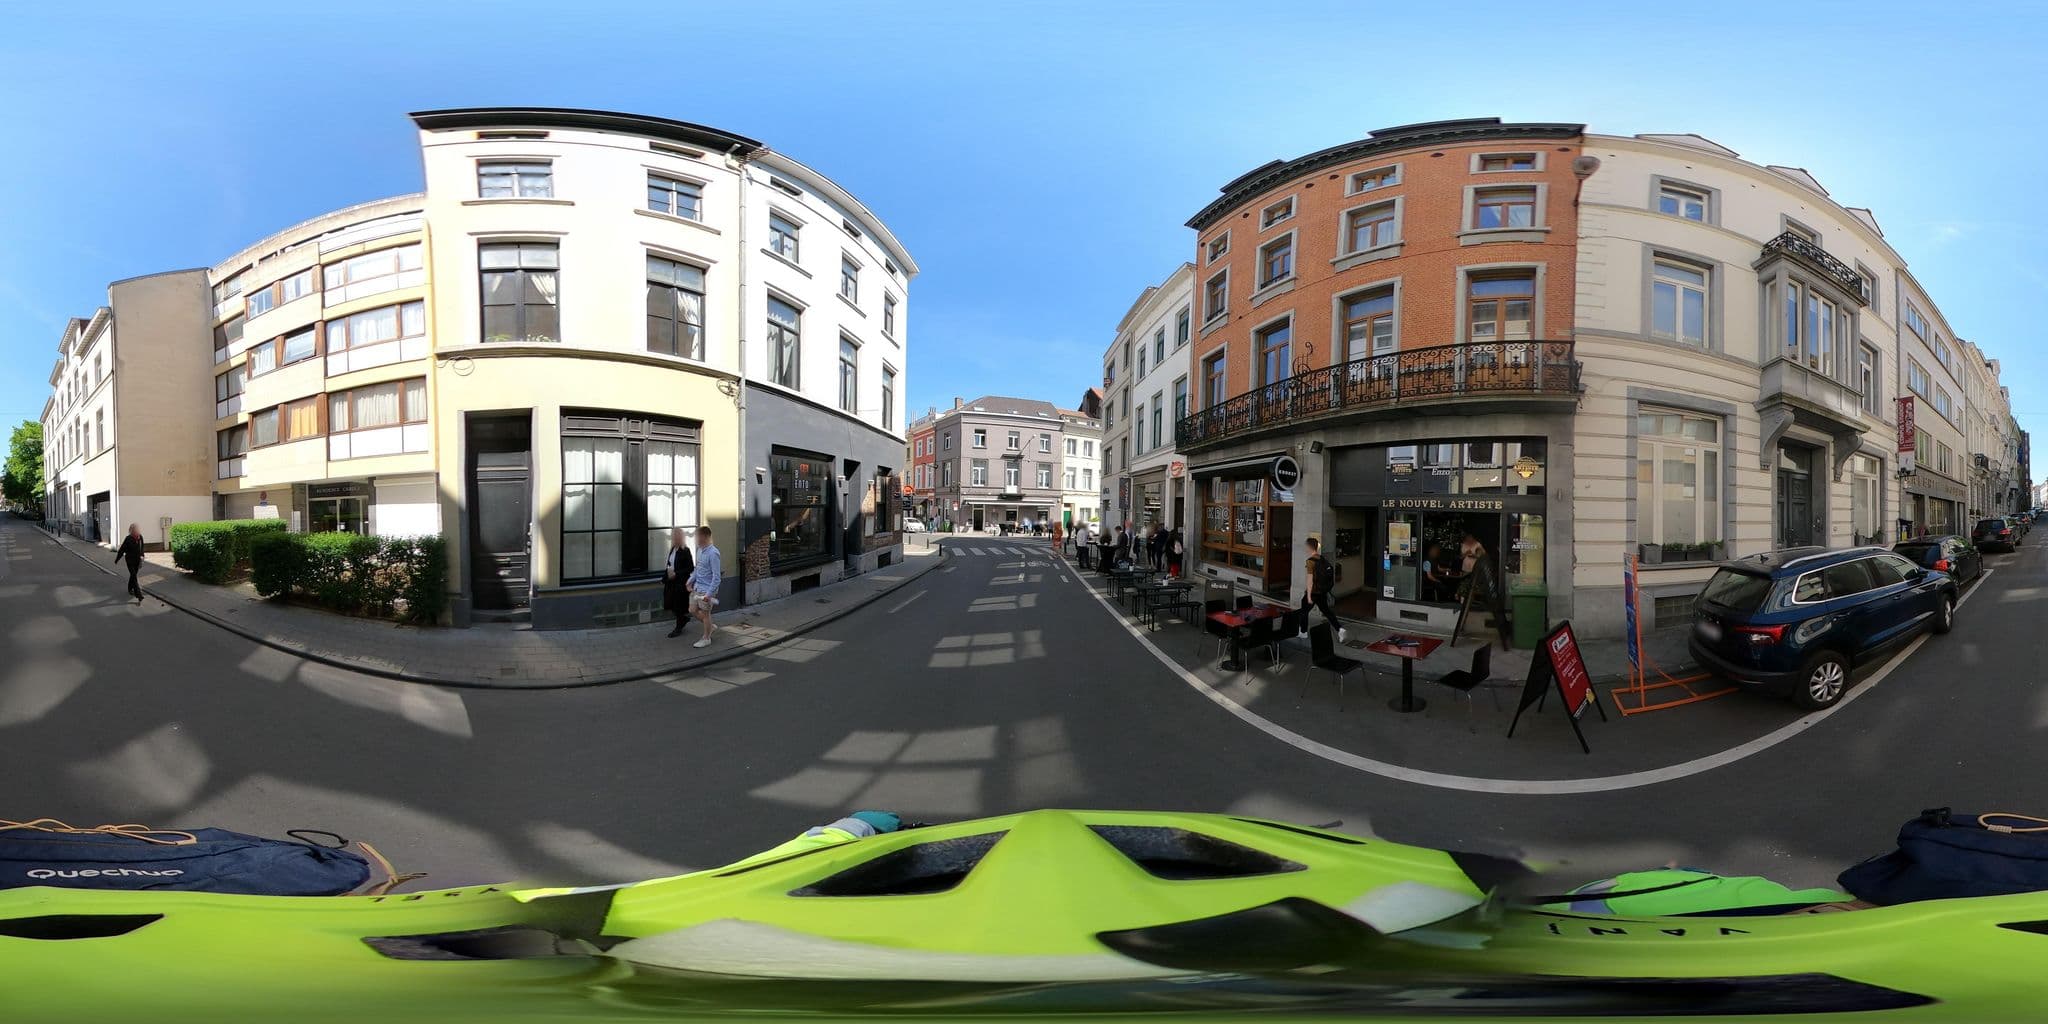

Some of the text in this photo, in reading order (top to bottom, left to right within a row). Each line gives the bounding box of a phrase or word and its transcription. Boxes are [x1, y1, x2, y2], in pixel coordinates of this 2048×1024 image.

[1382, 499, 1503, 510] LE NOUVEL ARTISTE
[26, 868, 185, 880] Quechua
